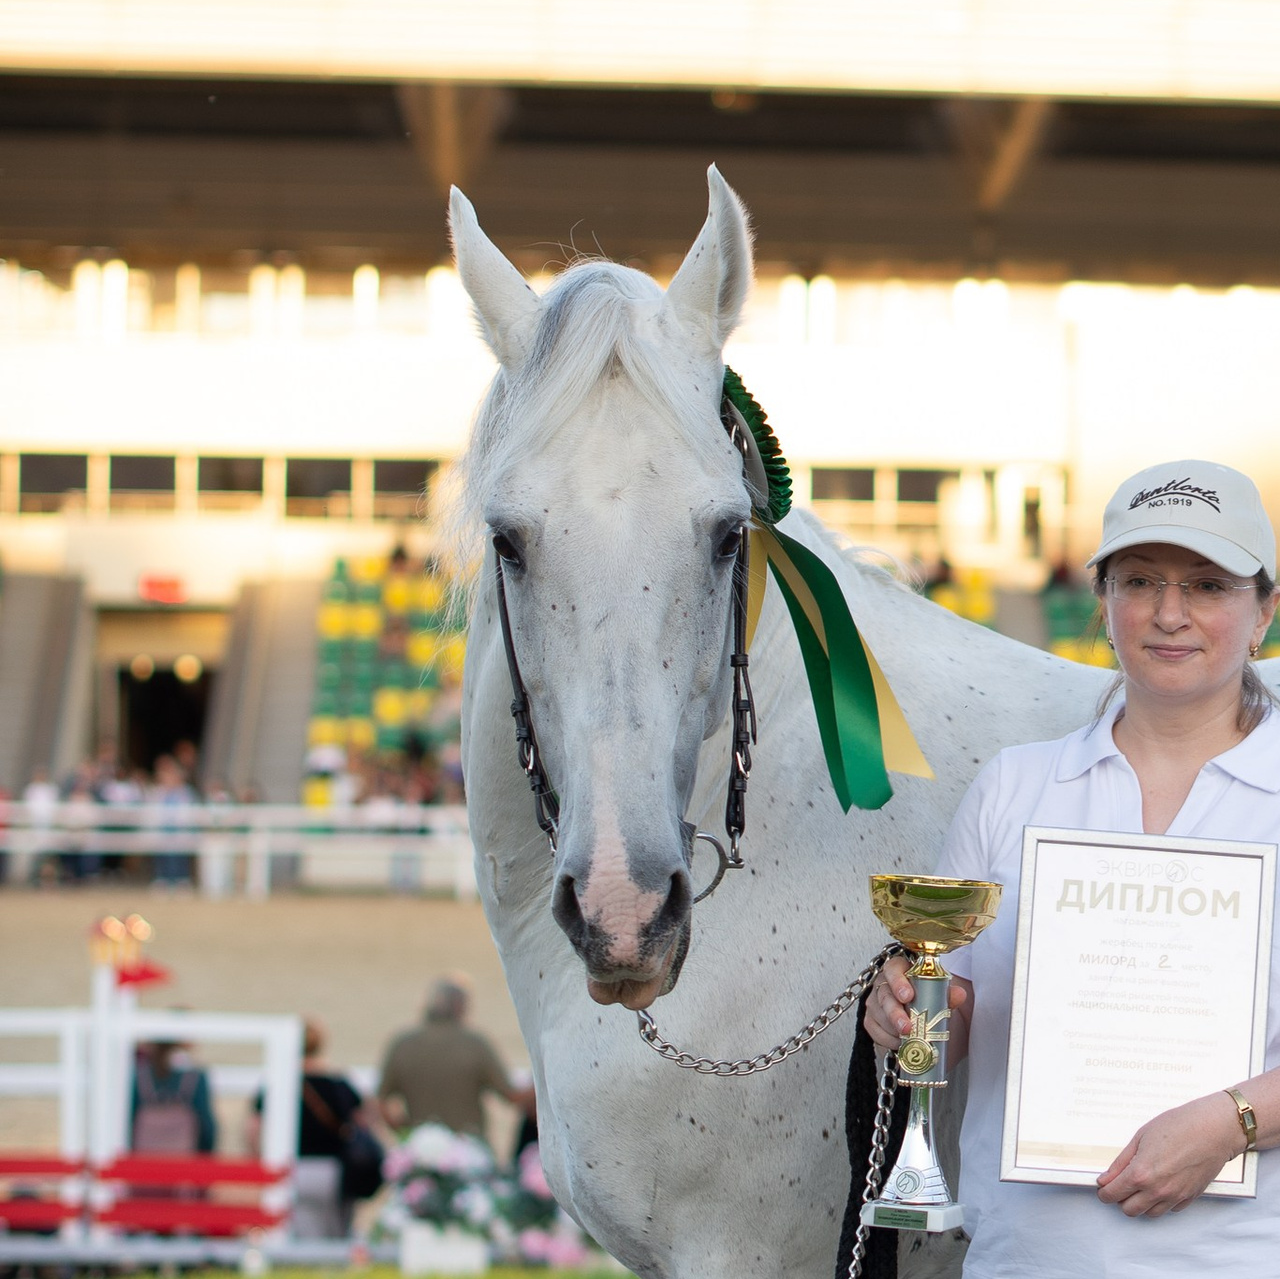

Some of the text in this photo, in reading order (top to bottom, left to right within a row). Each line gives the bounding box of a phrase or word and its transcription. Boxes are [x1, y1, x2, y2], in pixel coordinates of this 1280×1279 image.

[1148, 498, 1192, 508] NO.1919
[1056, 878, 1241, 919] ДИПЛОМ
[1079, 953, 1137, 969] МИЛОРД
[1158, 954, 1172, 969] 2
[911, 1049, 920, 1063] 2
[1085, 1057, 1192, 1073] ВОЙНОВОЙ ЕВГЕНИИ
